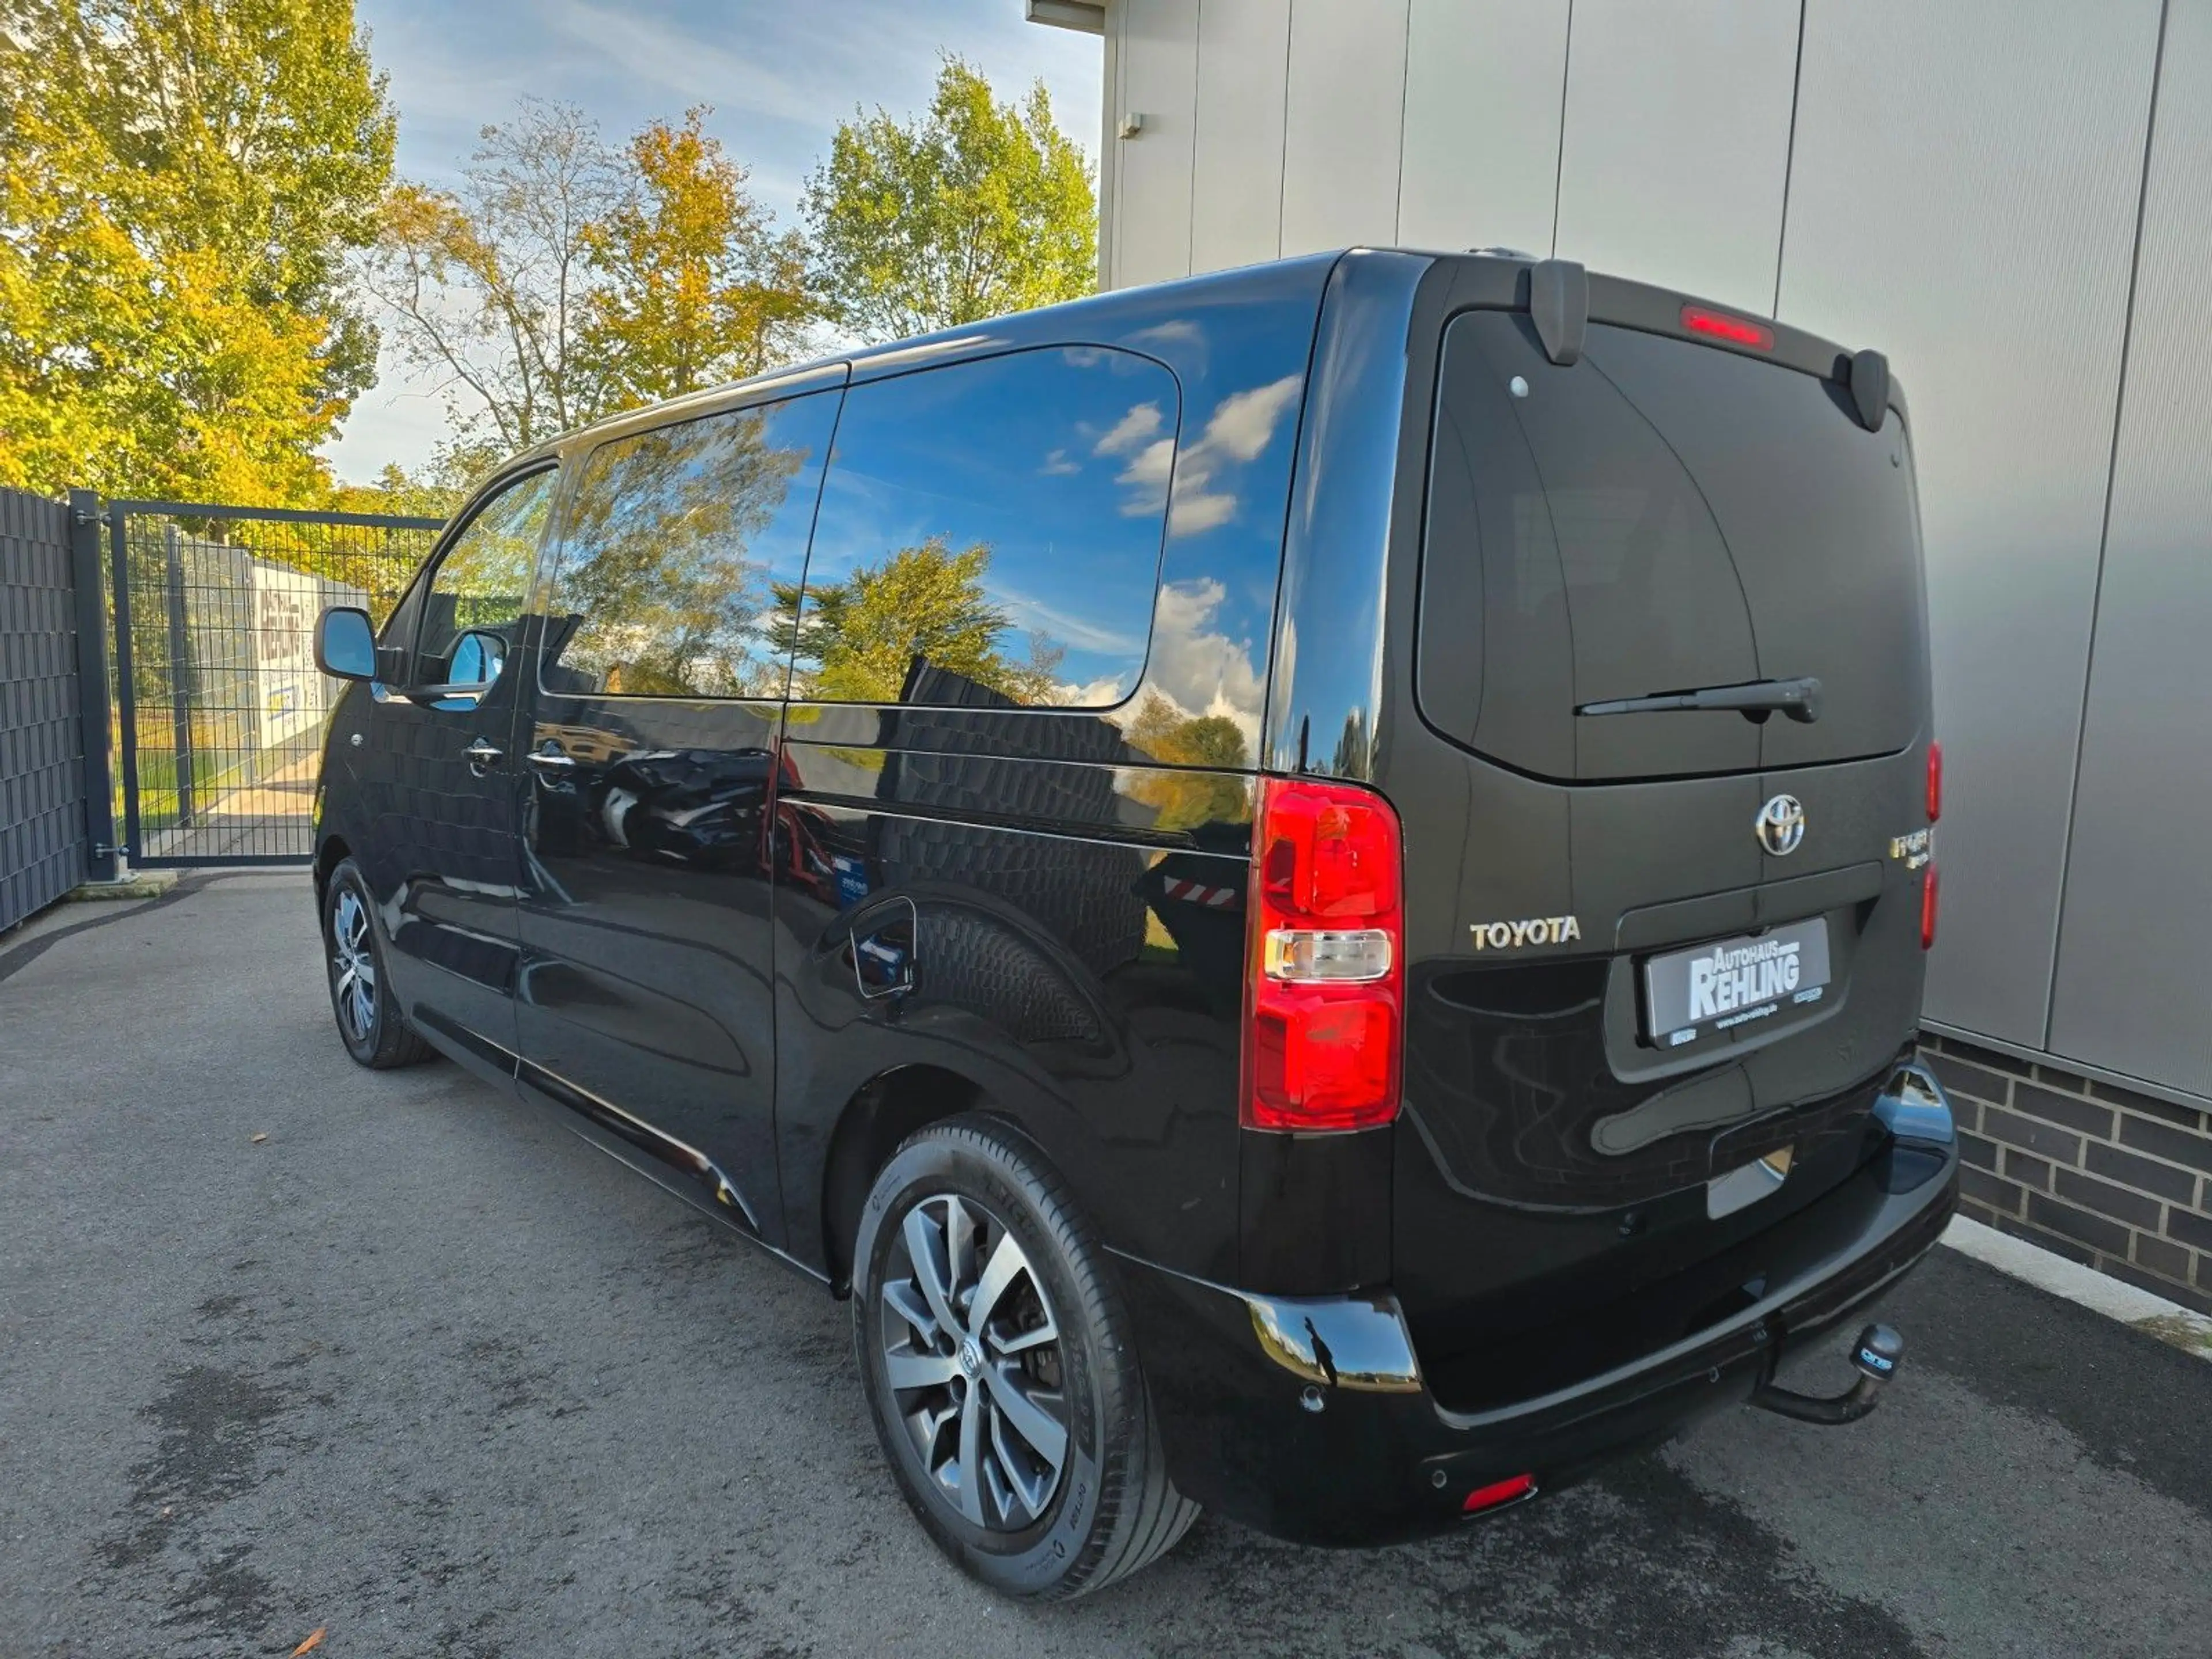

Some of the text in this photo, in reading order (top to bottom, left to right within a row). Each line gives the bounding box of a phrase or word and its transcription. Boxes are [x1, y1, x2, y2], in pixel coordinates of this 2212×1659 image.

[1469, 916, 1580, 950] TOYOTA
[1713, 940, 1779, 974] AUTOHAUS
[1689, 954, 1800, 1020] REHLING
